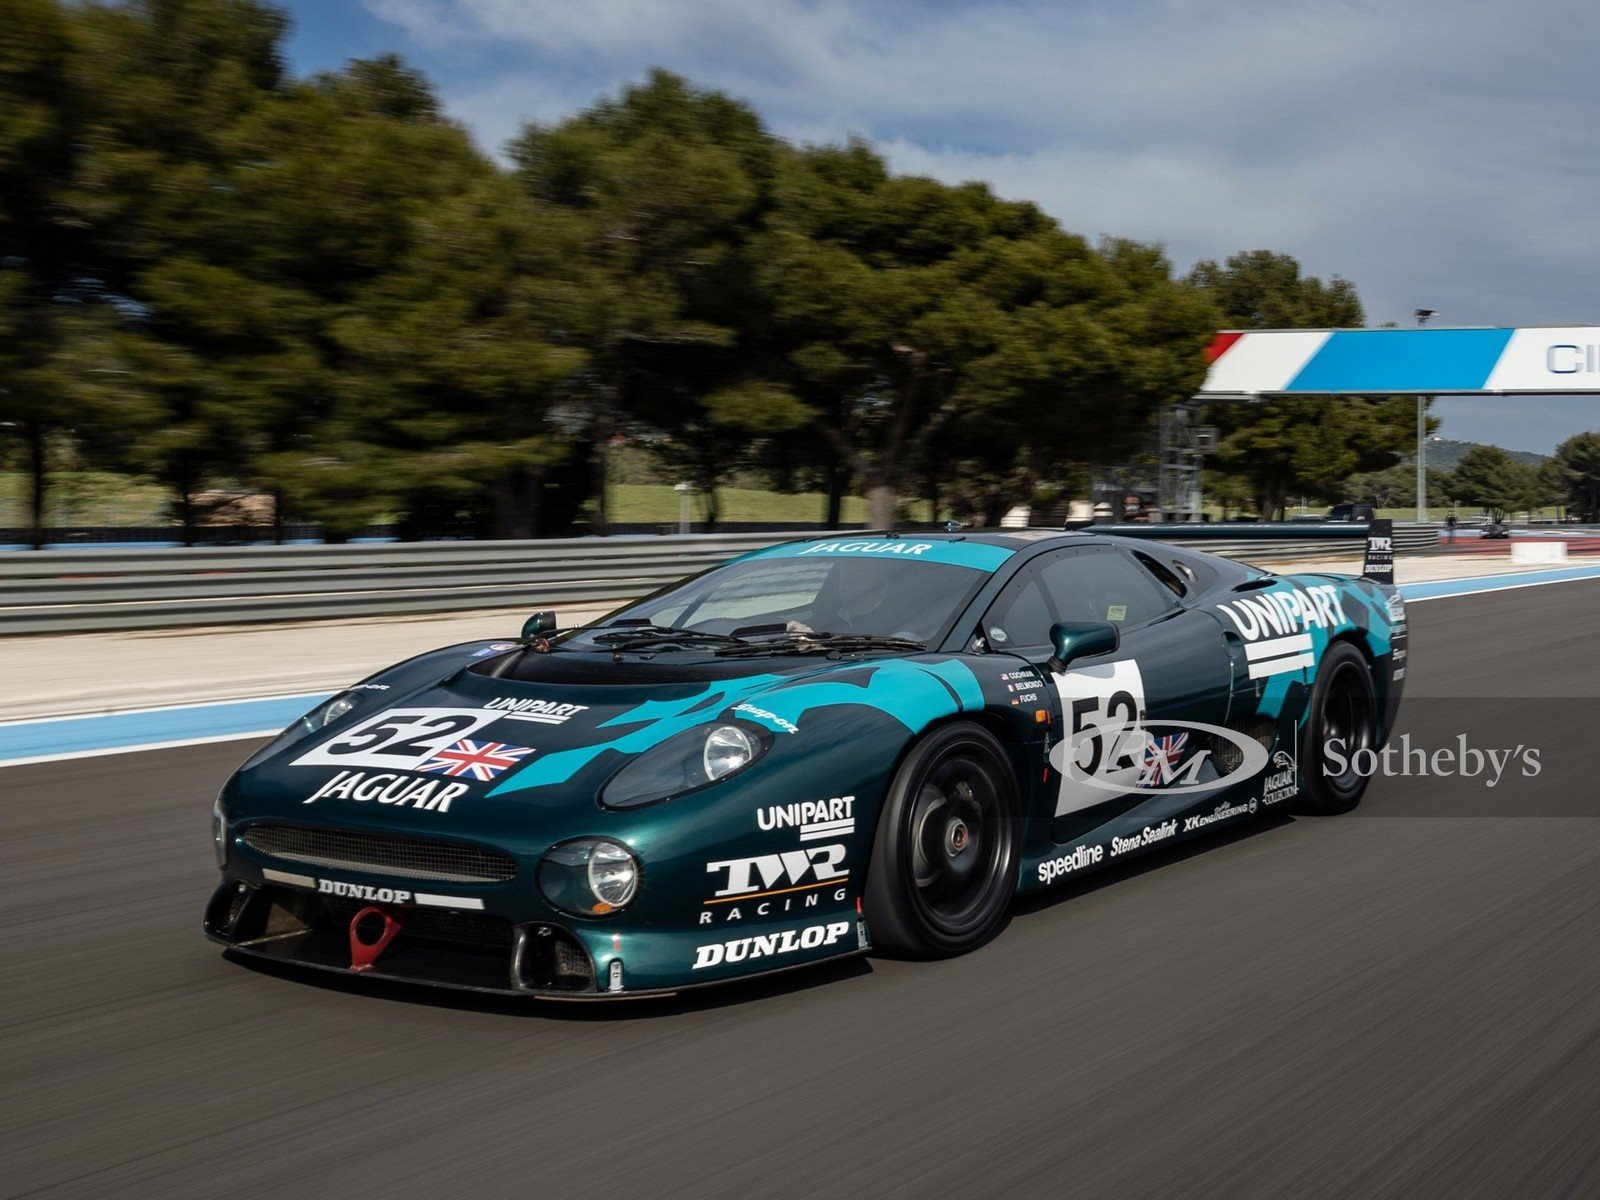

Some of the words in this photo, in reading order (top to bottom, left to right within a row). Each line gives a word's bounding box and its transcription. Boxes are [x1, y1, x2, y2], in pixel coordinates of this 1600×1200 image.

[1547, 344, 1600, 374] CI
[797, 542, 932, 555] JAGUAR
[1364, 564, 1393, 573] DUNLOP
[1216, 585, 1347, 641] UNIPART
[1014, 680, 1043, 691] BELMONDO
[1020, 693, 1037, 703] FUCHS
[483, 698, 589, 717] UNIPART
[326, 714, 477, 757] 52
[1072, 690, 1138, 778] 52
[302, 770, 471, 813] JAGUAR
[1263, 769, 1294, 796] JAGUAR
[757, 796, 855, 830] UNIPART
[706, 843, 850, 898] TWR
[1037, 843, 1104, 884] speedline
[1110, 834, 1141, 857] Stena
[318, 878, 411, 904] DUNLOP
[699, 888, 847, 925] RACING
[692, 921, 850, 970] DUNLOP
